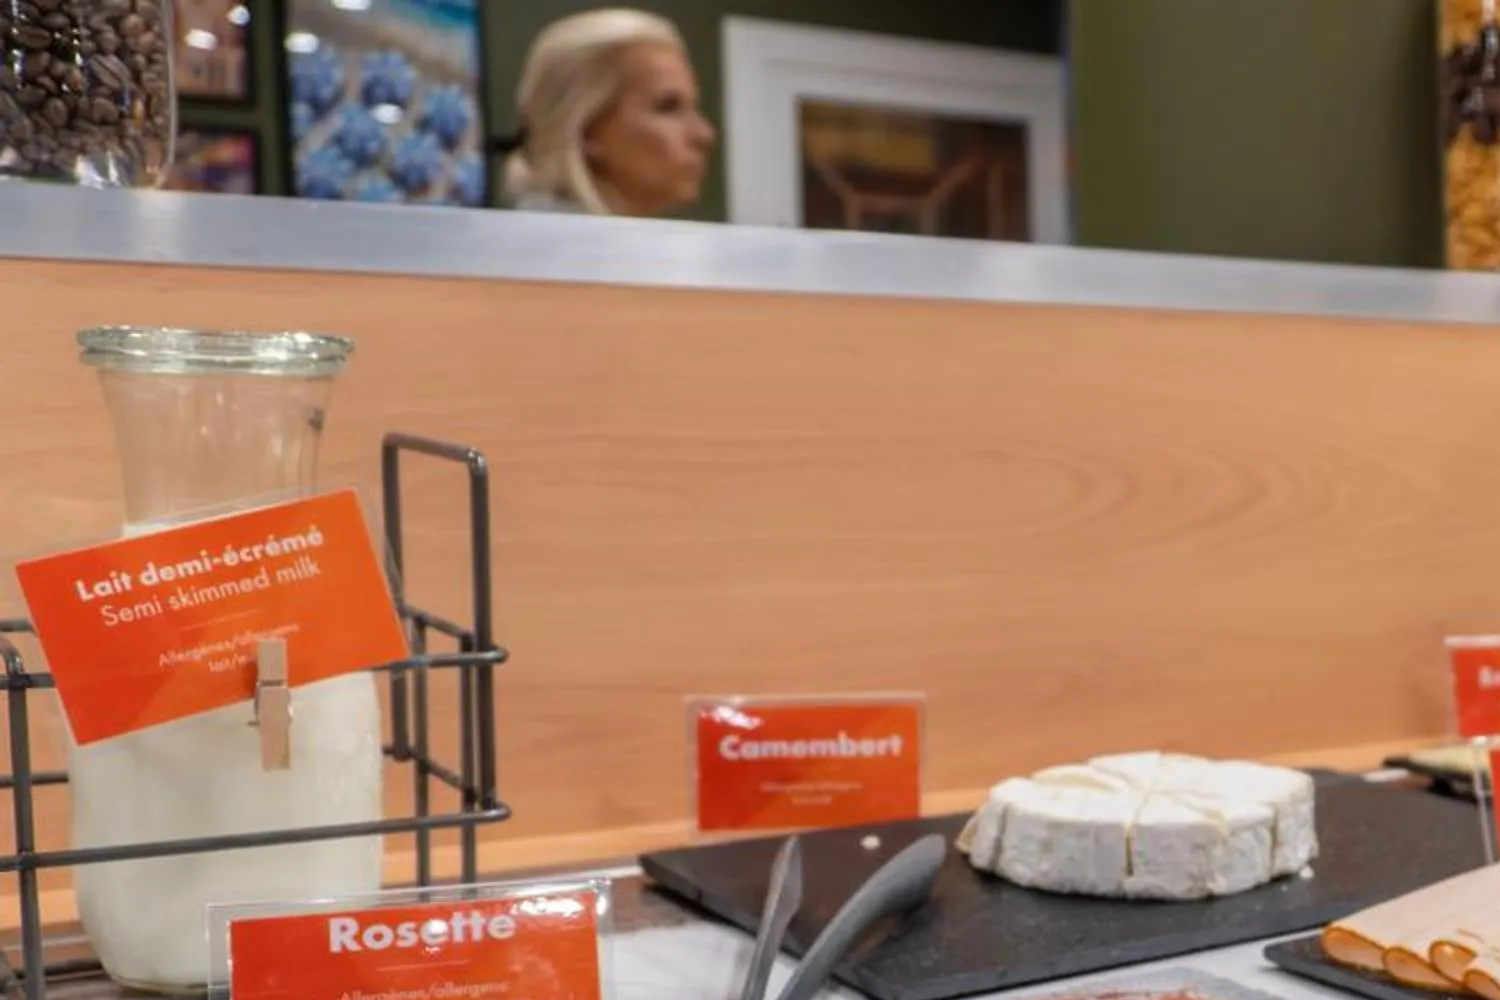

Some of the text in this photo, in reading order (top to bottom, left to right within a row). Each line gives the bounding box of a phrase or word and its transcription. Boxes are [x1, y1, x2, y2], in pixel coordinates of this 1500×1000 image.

[76, 523, 324, 602] Lait demi-écrémé
[100, 555, 322, 627] Semi skimmed milk
[719, 731, 904, 761] Camembert
[328, 910, 517, 954] Rosette
